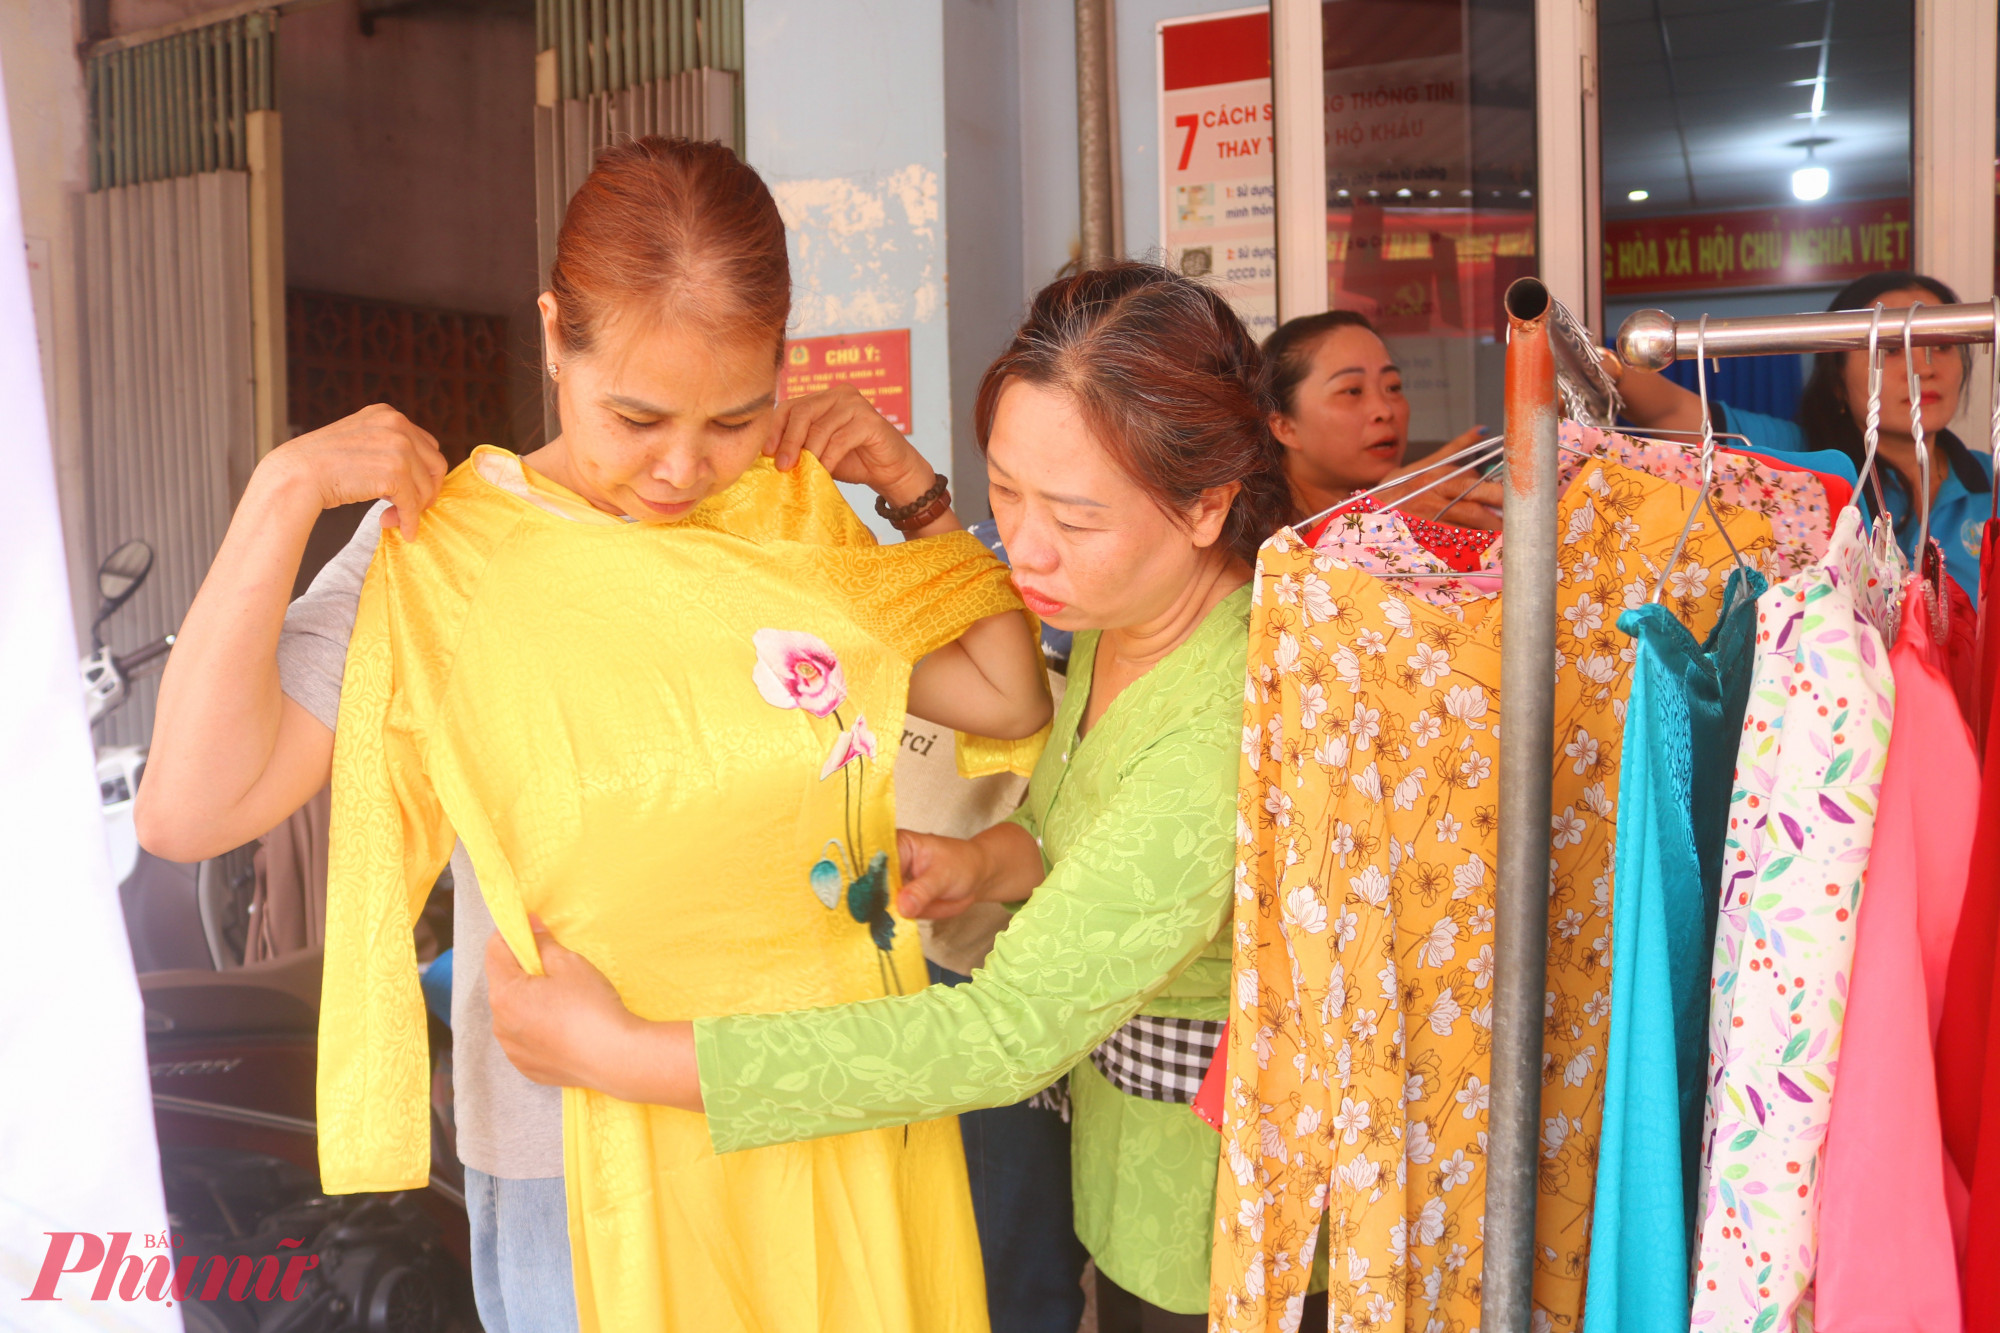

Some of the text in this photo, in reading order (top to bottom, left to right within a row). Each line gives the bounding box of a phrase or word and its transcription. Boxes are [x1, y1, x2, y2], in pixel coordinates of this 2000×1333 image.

[1202, 103, 1257, 128] CÁCH
[1350, 83, 1420, 110] THÔNG
[1424, 81, 1455, 102] TIN
[1175, 113, 1199, 171] 7
[1216, 137, 1262, 159] THAY
[1335, 121, 1364, 149] HỘ
[1370, 112, 1424, 142] KHẨU
[1251, 203, 1274, 217] thôn
[1618, 230, 1660, 280] HÒA
[1665, 227, 1692, 276] XÃ
[1698, 223, 1735, 281] HỘI
[1740, 214, 1782, 271] CHỦ
[1789, 216, 1854, 267] NGHĨA
[1859, 211, 1909, 270] VIỆT
[825, 342, 881, 365] CHÚ Ý:
[900, 729, 938, 756] rci
